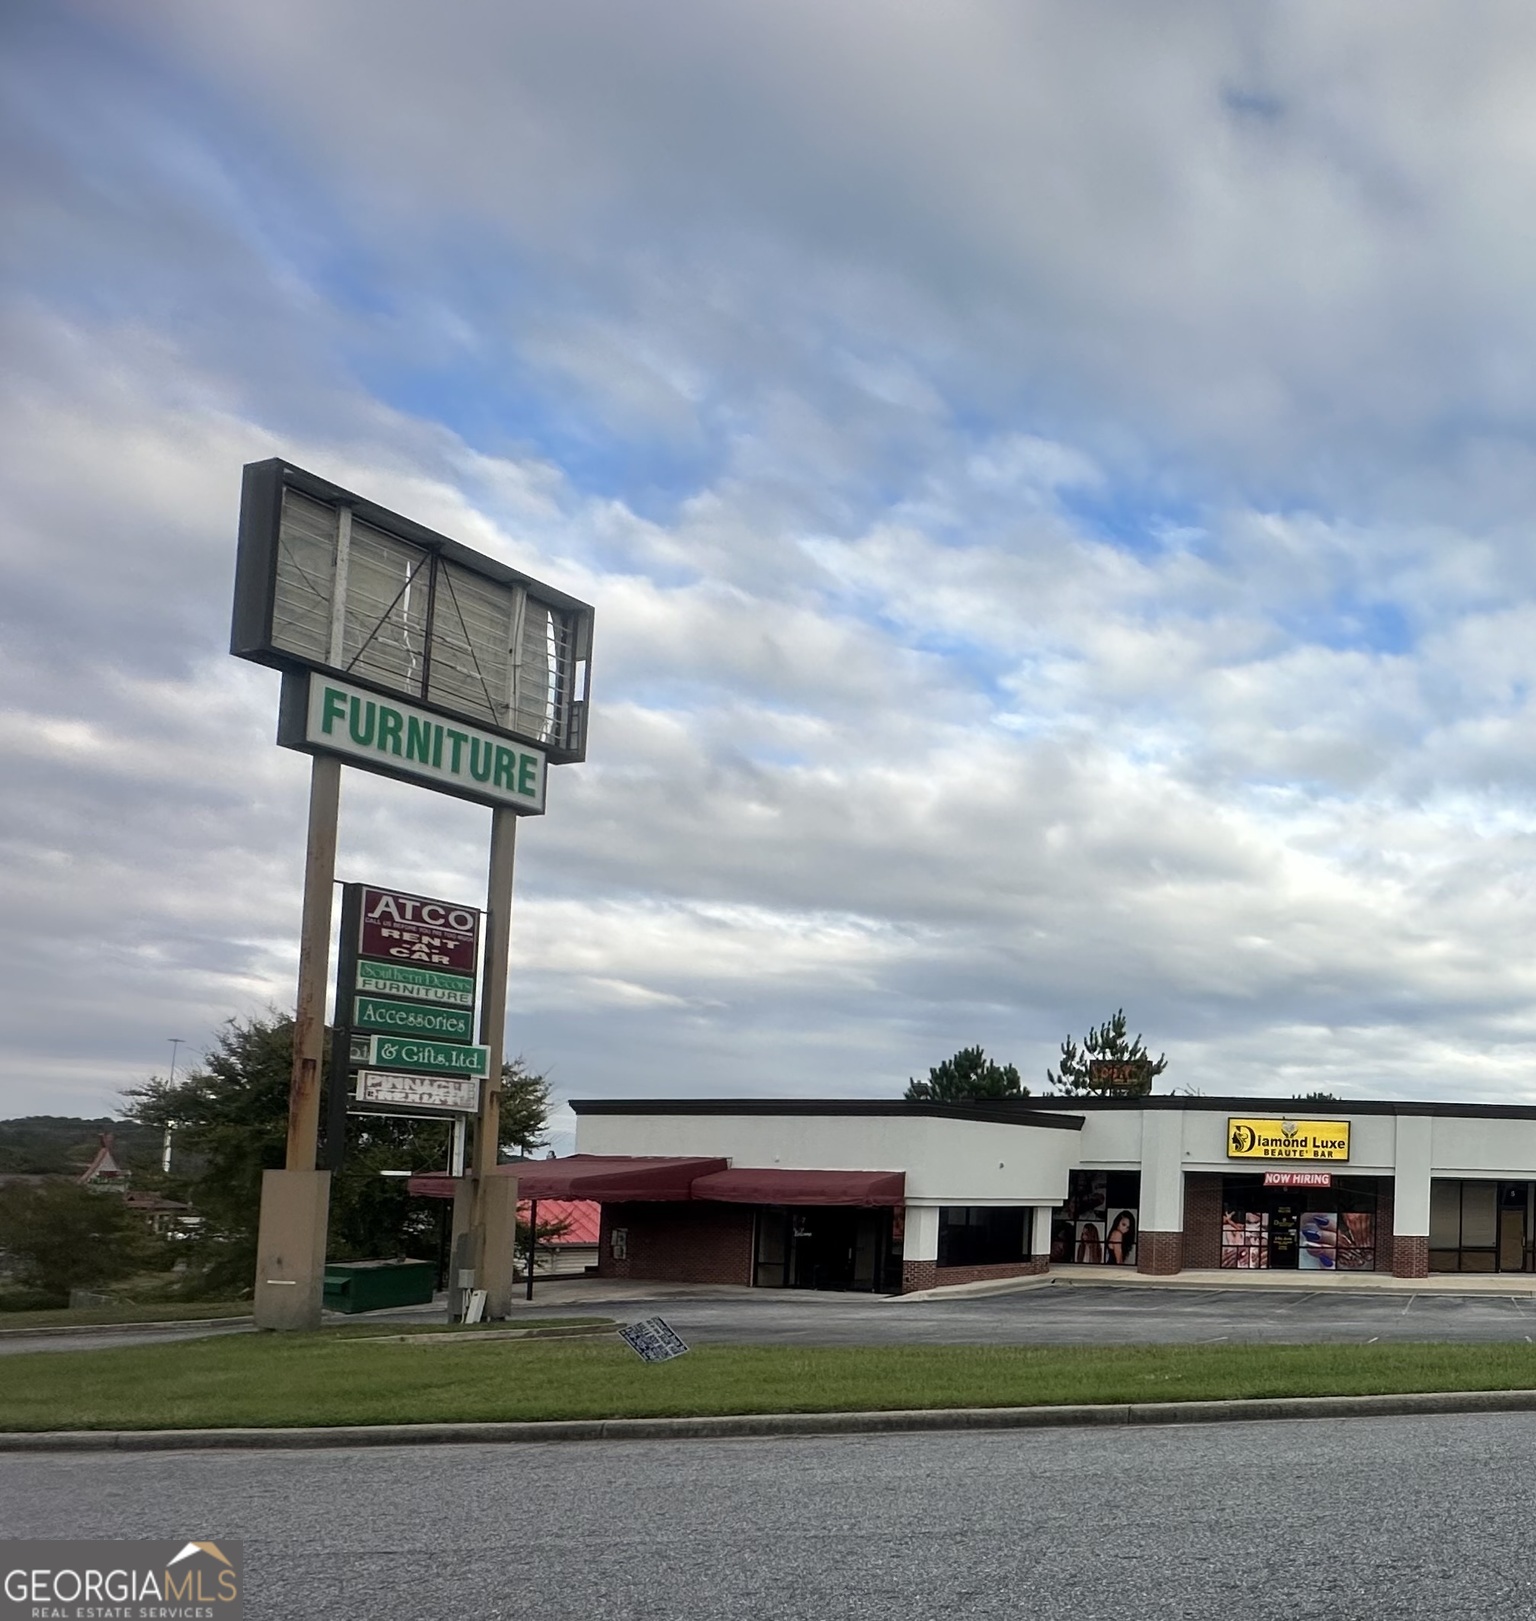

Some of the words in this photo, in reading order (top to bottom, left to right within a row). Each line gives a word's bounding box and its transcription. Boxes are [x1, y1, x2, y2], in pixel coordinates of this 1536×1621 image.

[321, 686, 538, 797] FURNITURE
[367, 895, 474, 931] ATCO
[381, 927, 460, 949] RENT
[389, 947, 450, 965] CAR
[362, 979, 470, 1003] FURNITURE
[363, 1004, 466, 1033] Accessories
[381, 1043, 399, 1060] &
[451, 1051, 481, 1068] Ltd.
[1312, 1137, 1346, 1149] Luxe
[1313, 1150, 1333, 1158] BAR
[1264, 1173, 1290, 1184] NOW
[1292, 1174, 1330, 1185] HIRING
